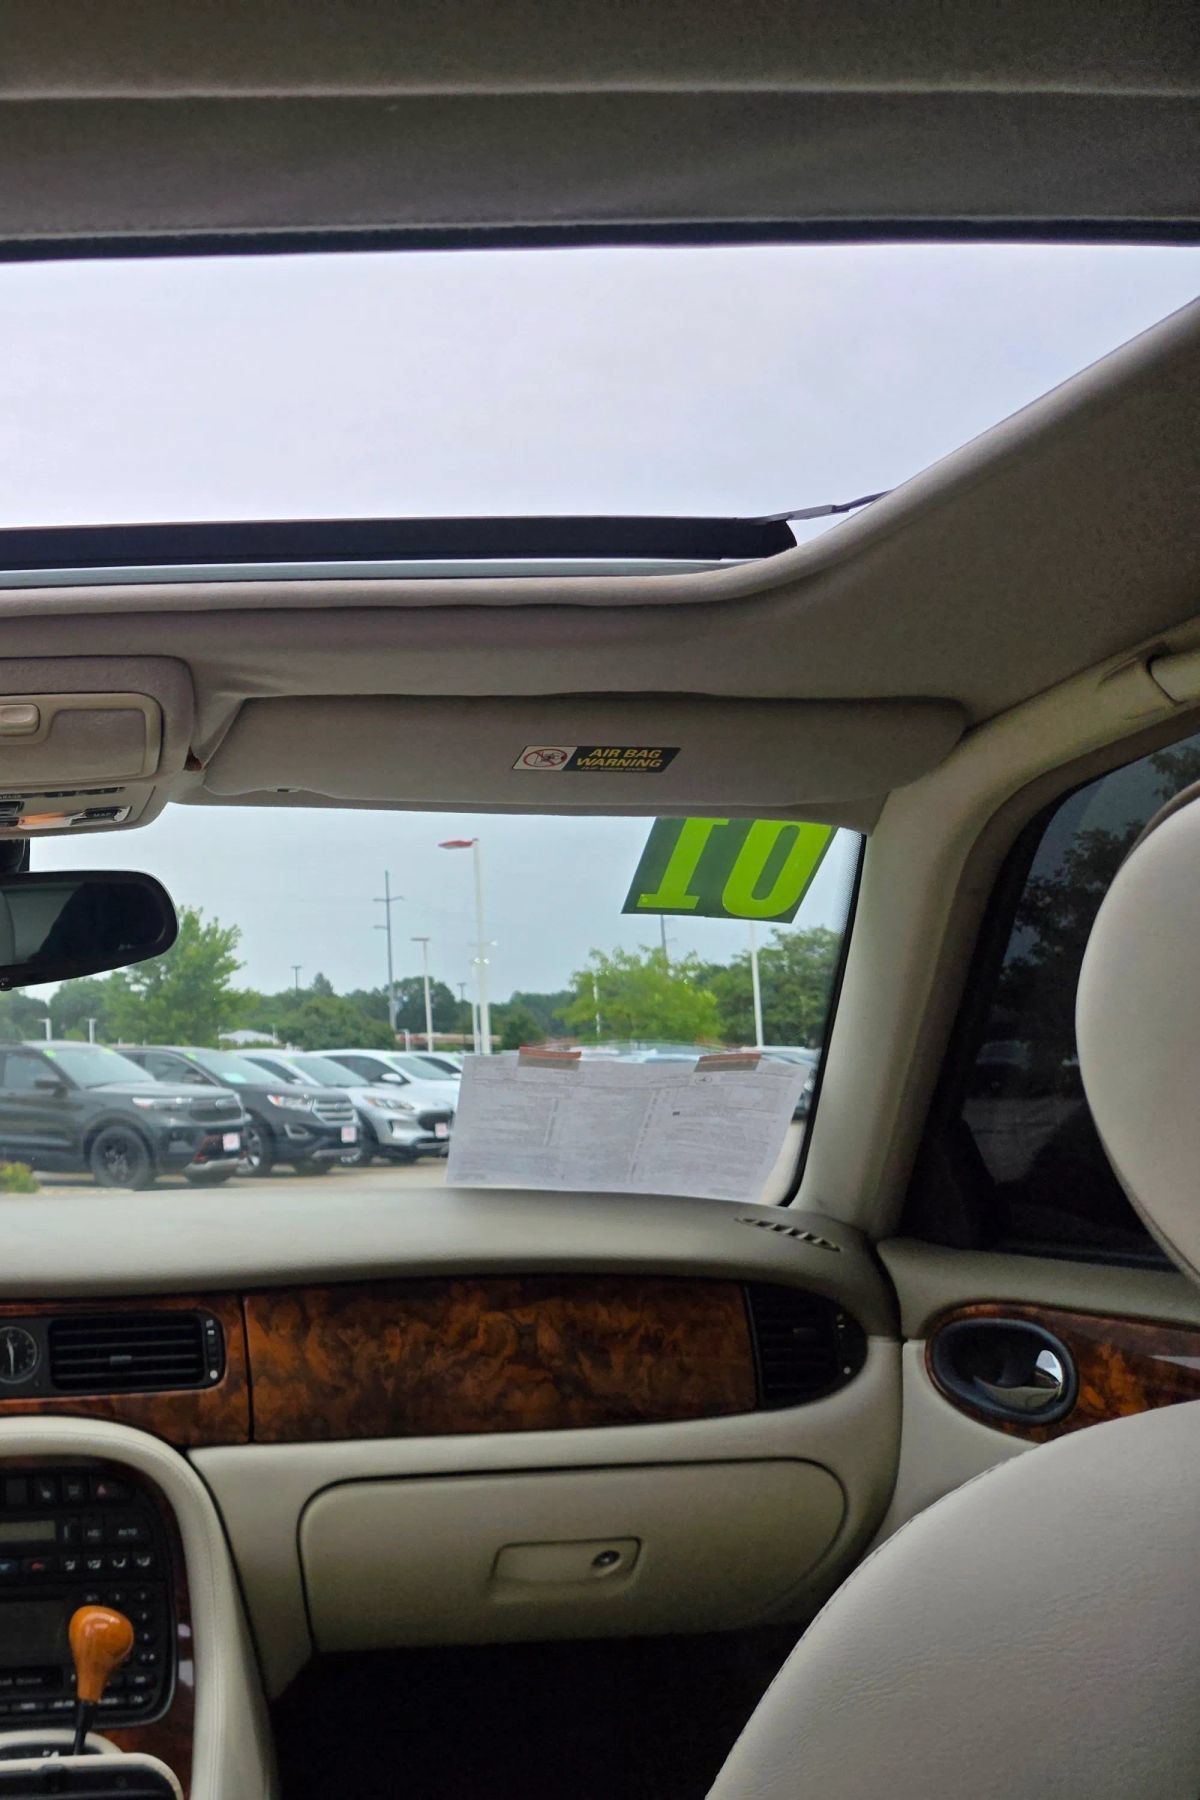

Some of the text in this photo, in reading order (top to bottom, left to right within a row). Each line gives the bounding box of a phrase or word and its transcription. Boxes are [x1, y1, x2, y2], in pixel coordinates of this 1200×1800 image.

[588, 748, 663, 759] AIR BAG
[575, 757, 664, 768] WARNING
